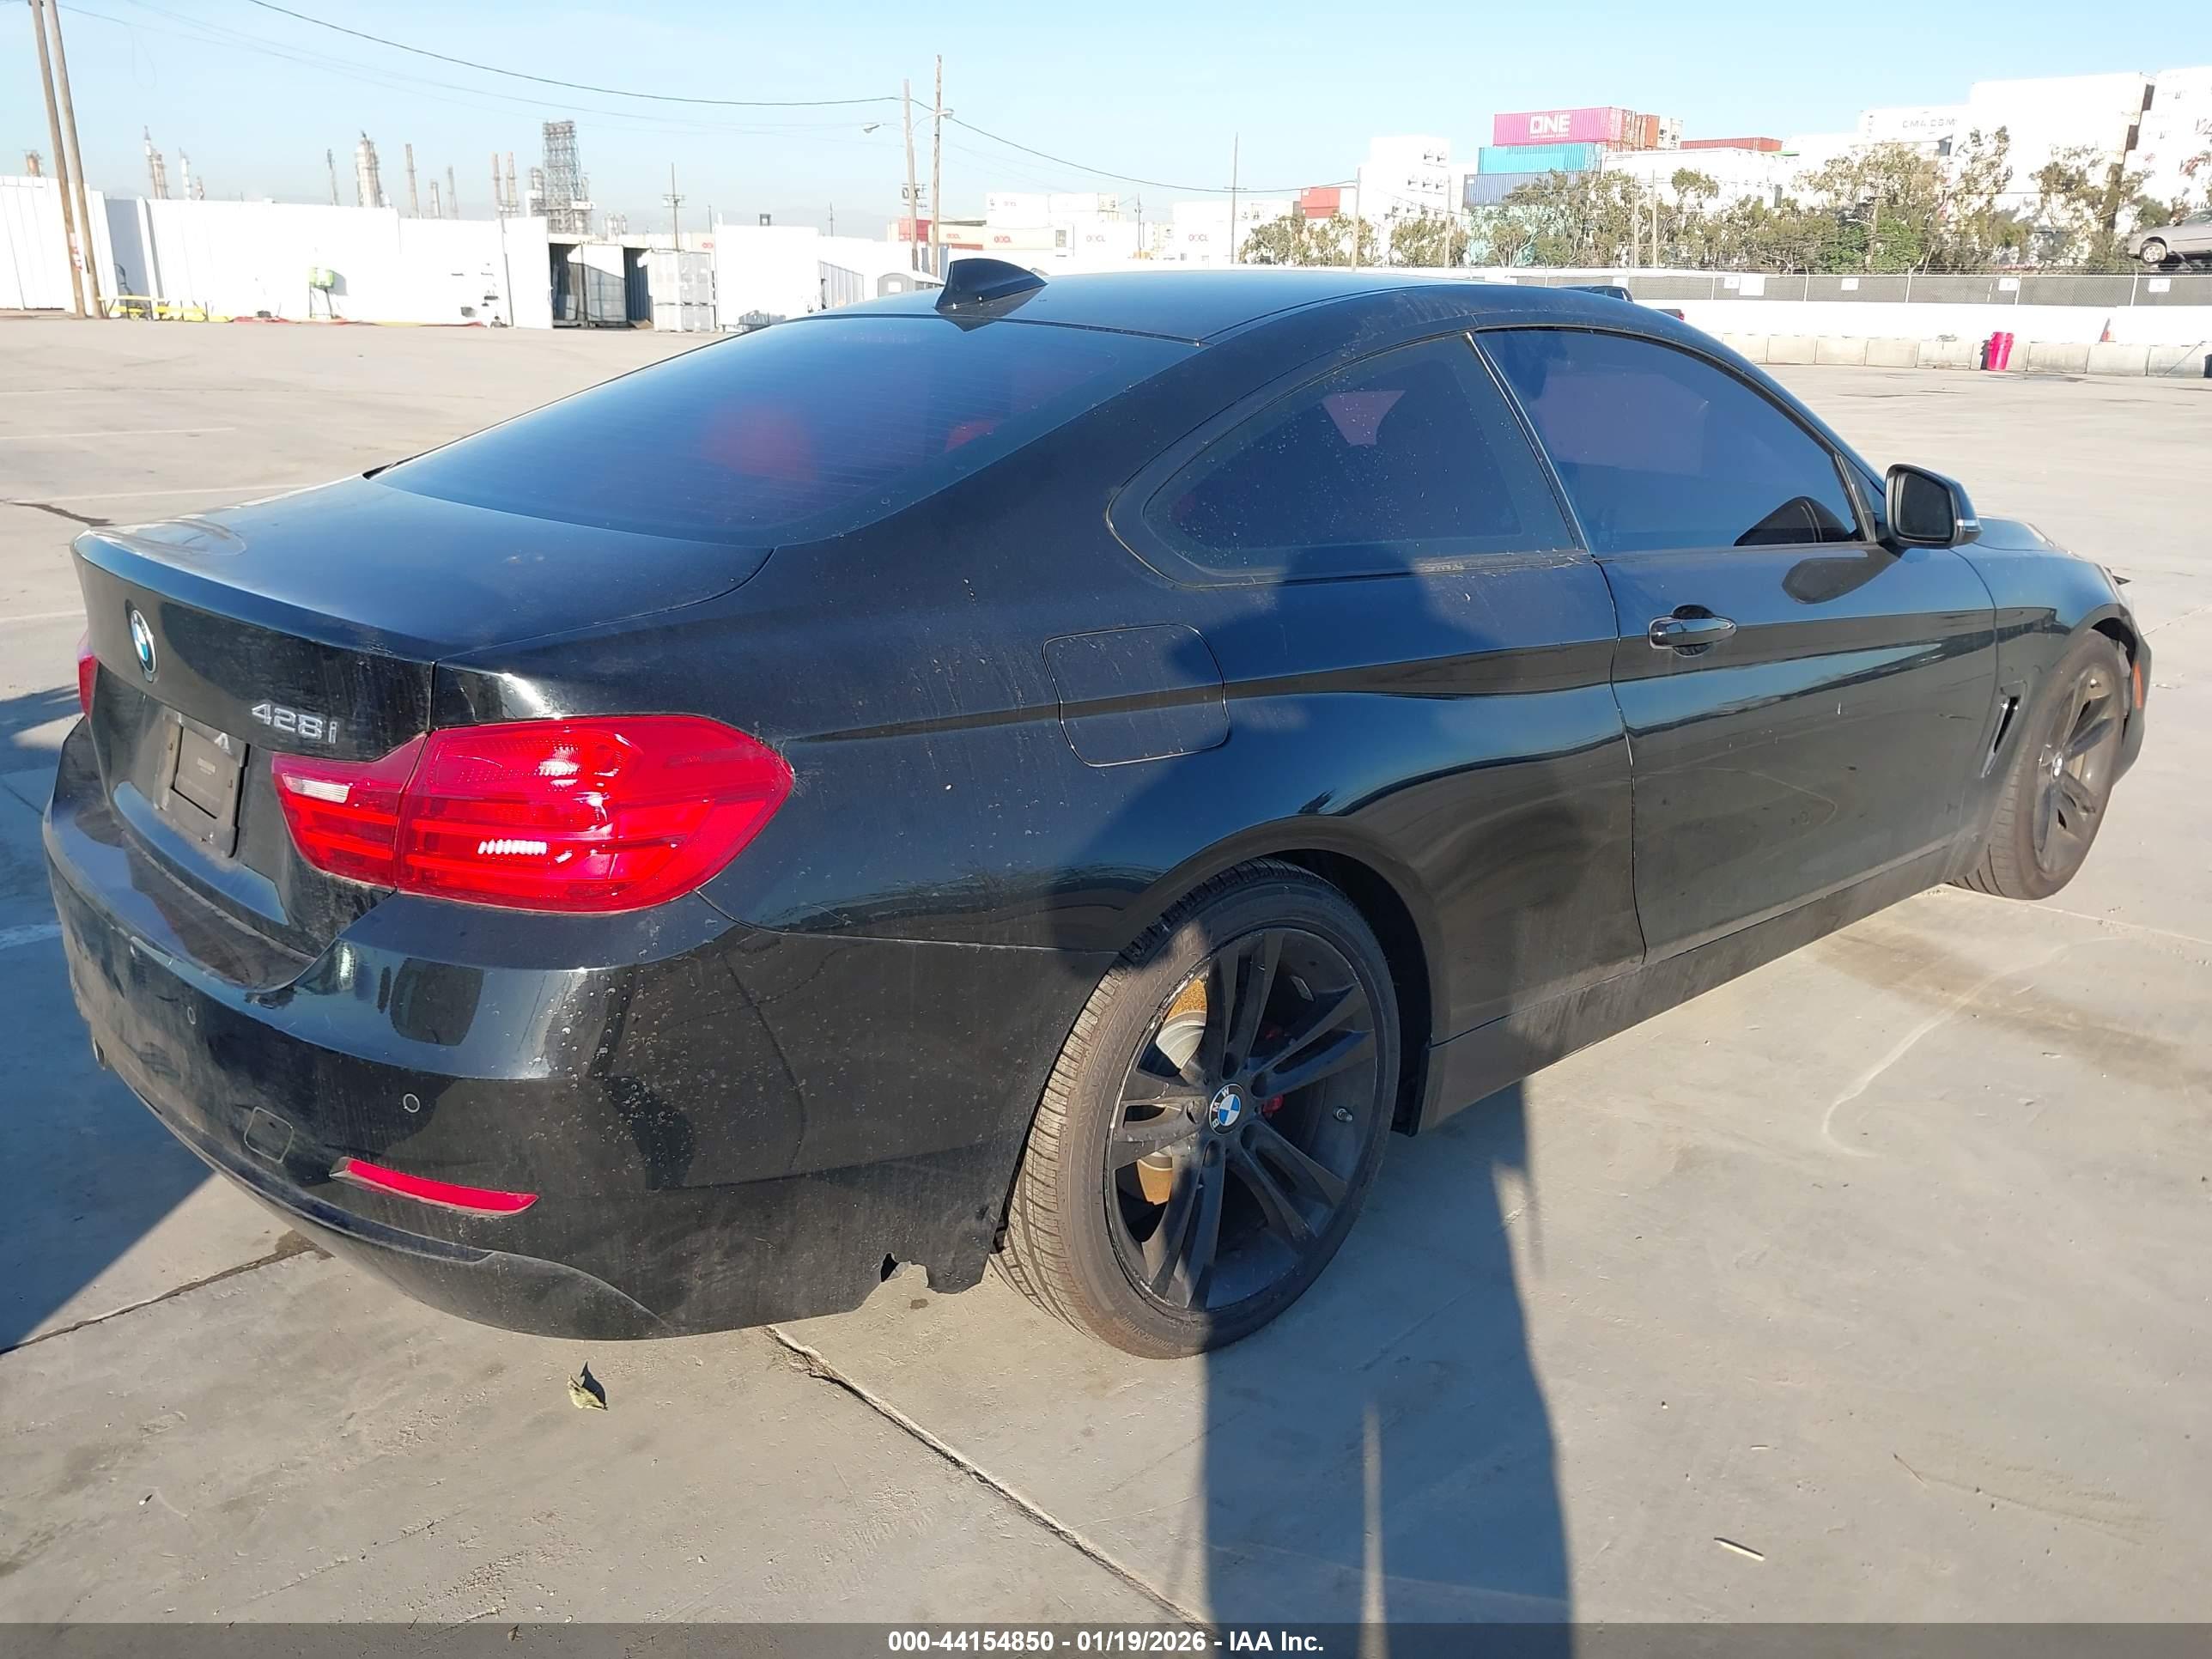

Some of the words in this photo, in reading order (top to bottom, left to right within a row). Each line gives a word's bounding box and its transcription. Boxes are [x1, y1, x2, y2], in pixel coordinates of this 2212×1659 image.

[1530, 113, 1570, 134] ONE
[252, 703, 337, 744] 428i
[1212, 1087, 1230, 1129] BMW
